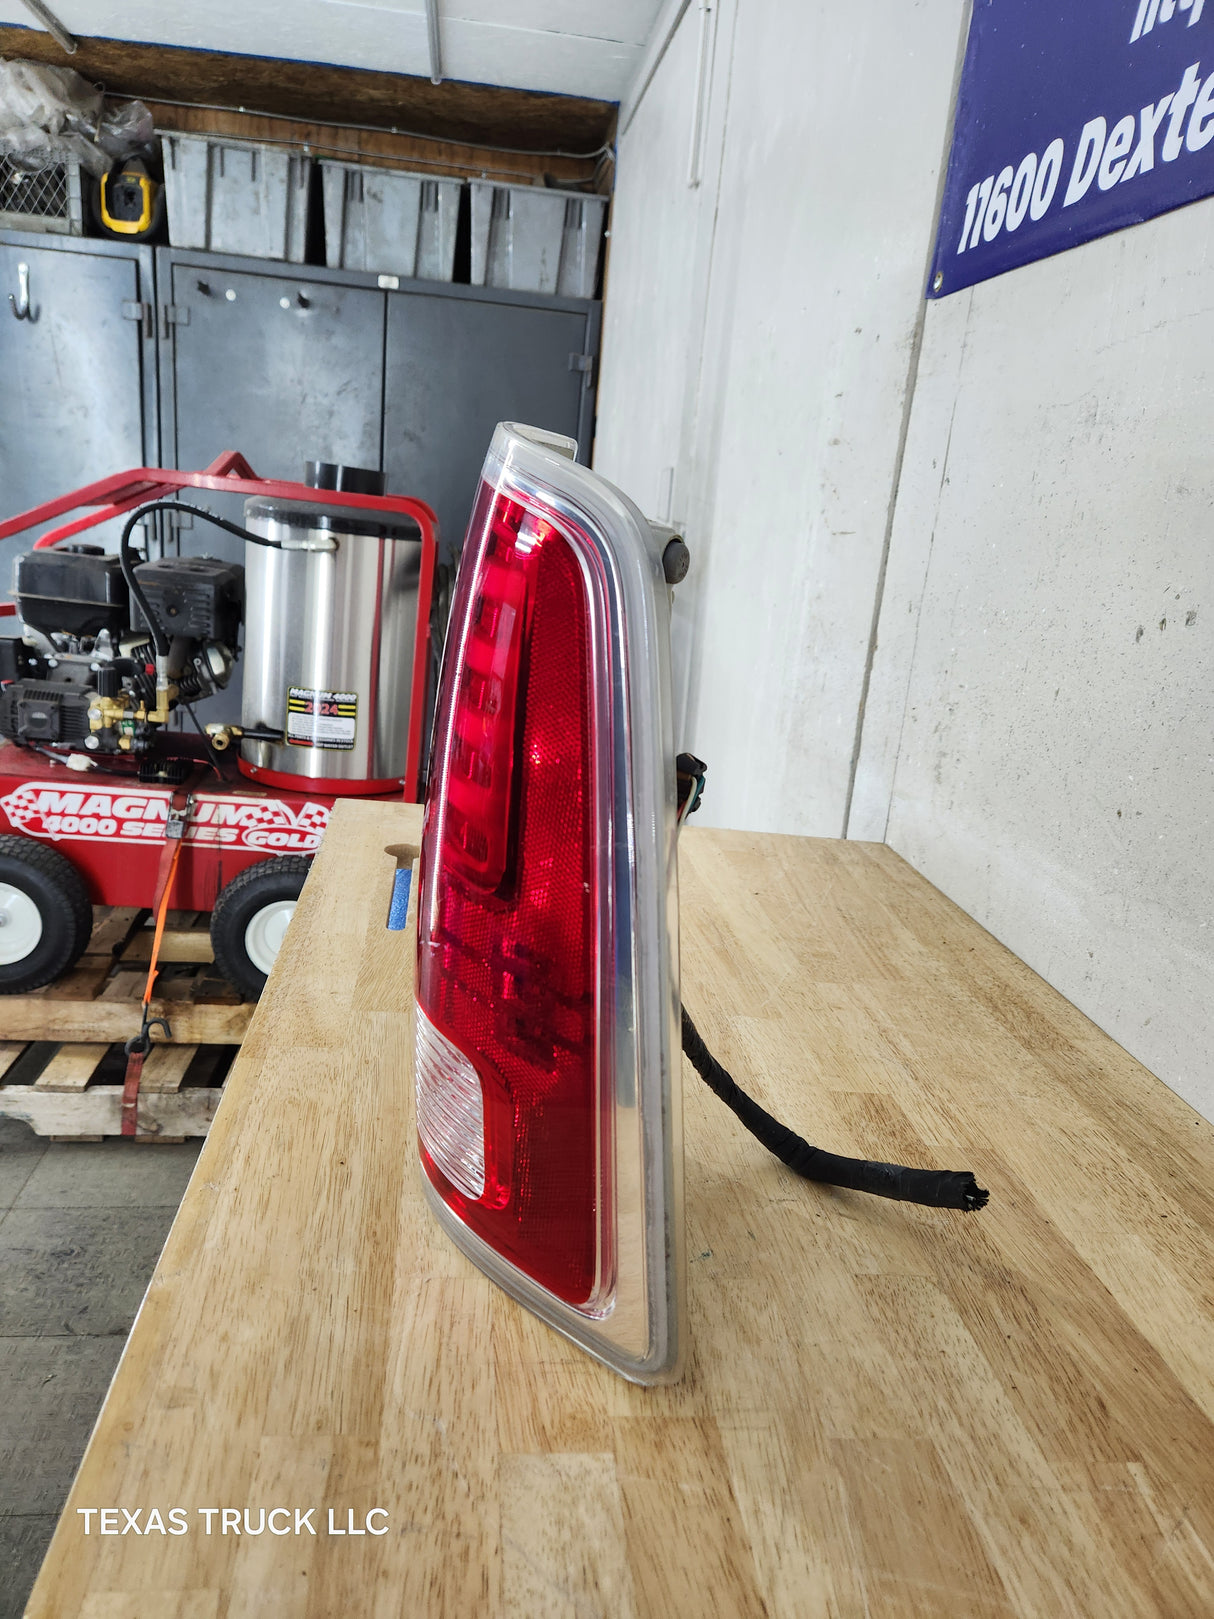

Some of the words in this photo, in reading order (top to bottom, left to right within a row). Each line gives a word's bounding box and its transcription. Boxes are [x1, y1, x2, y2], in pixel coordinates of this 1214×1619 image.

[957, 138, 1064, 255] 11600
[120, 821, 239, 842] SEIES
[247, 830, 322, 849] GOLD
